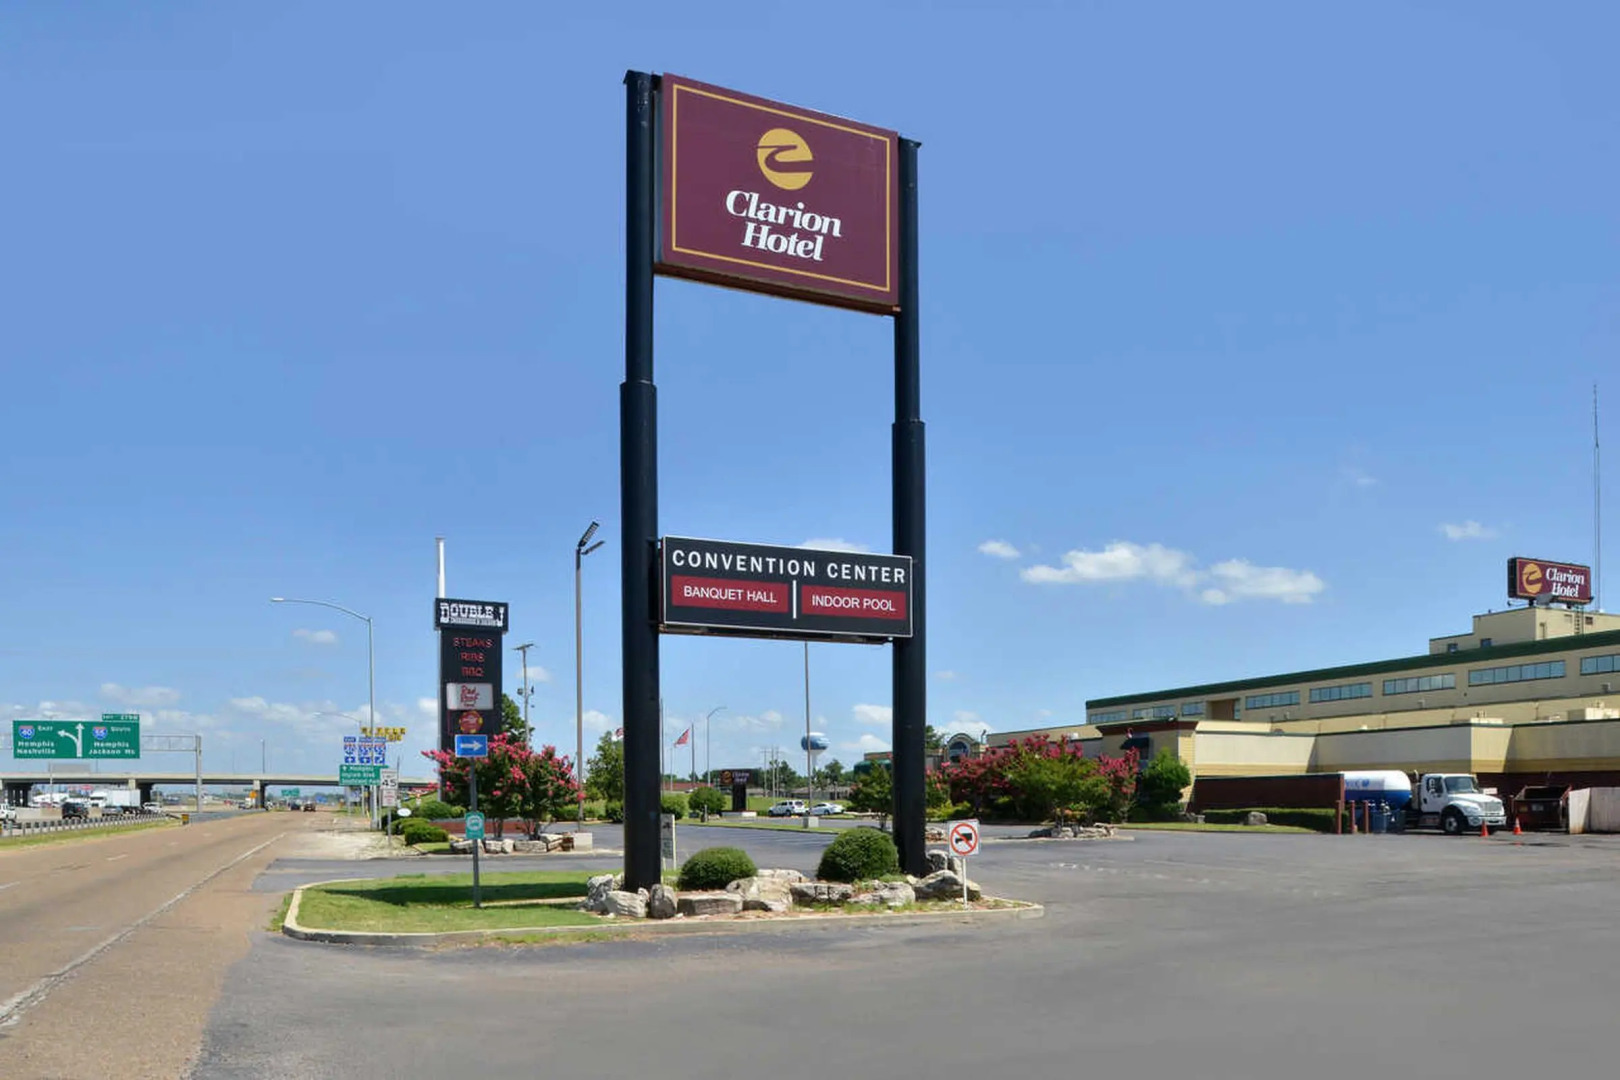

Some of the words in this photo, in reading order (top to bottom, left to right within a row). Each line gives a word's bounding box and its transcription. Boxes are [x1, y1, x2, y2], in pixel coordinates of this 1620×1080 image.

[725, 190, 842, 237] Clarion
[741, 221, 824, 261] Hotel
[672, 549, 815, 577] CONVENTION
[827, 562, 906, 583] CENTER
[1545, 567, 1585, 585] Clarion
[683, 585, 743, 601] BANQUET
[747, 590, 777, 604] HALL
[1551, 582, 1579, 598] Hotel
[811, 595, 860, 609] INDOOR
[863, 598, 896, 611] POOL
[440, 602, 494, 624] DOUBLE
[496, 606, 505, 627] J
[453, 637, 494, 648] STEAKS
[460, 652, 485, 663] RIBS
[382, 779, 397, 787] 45
